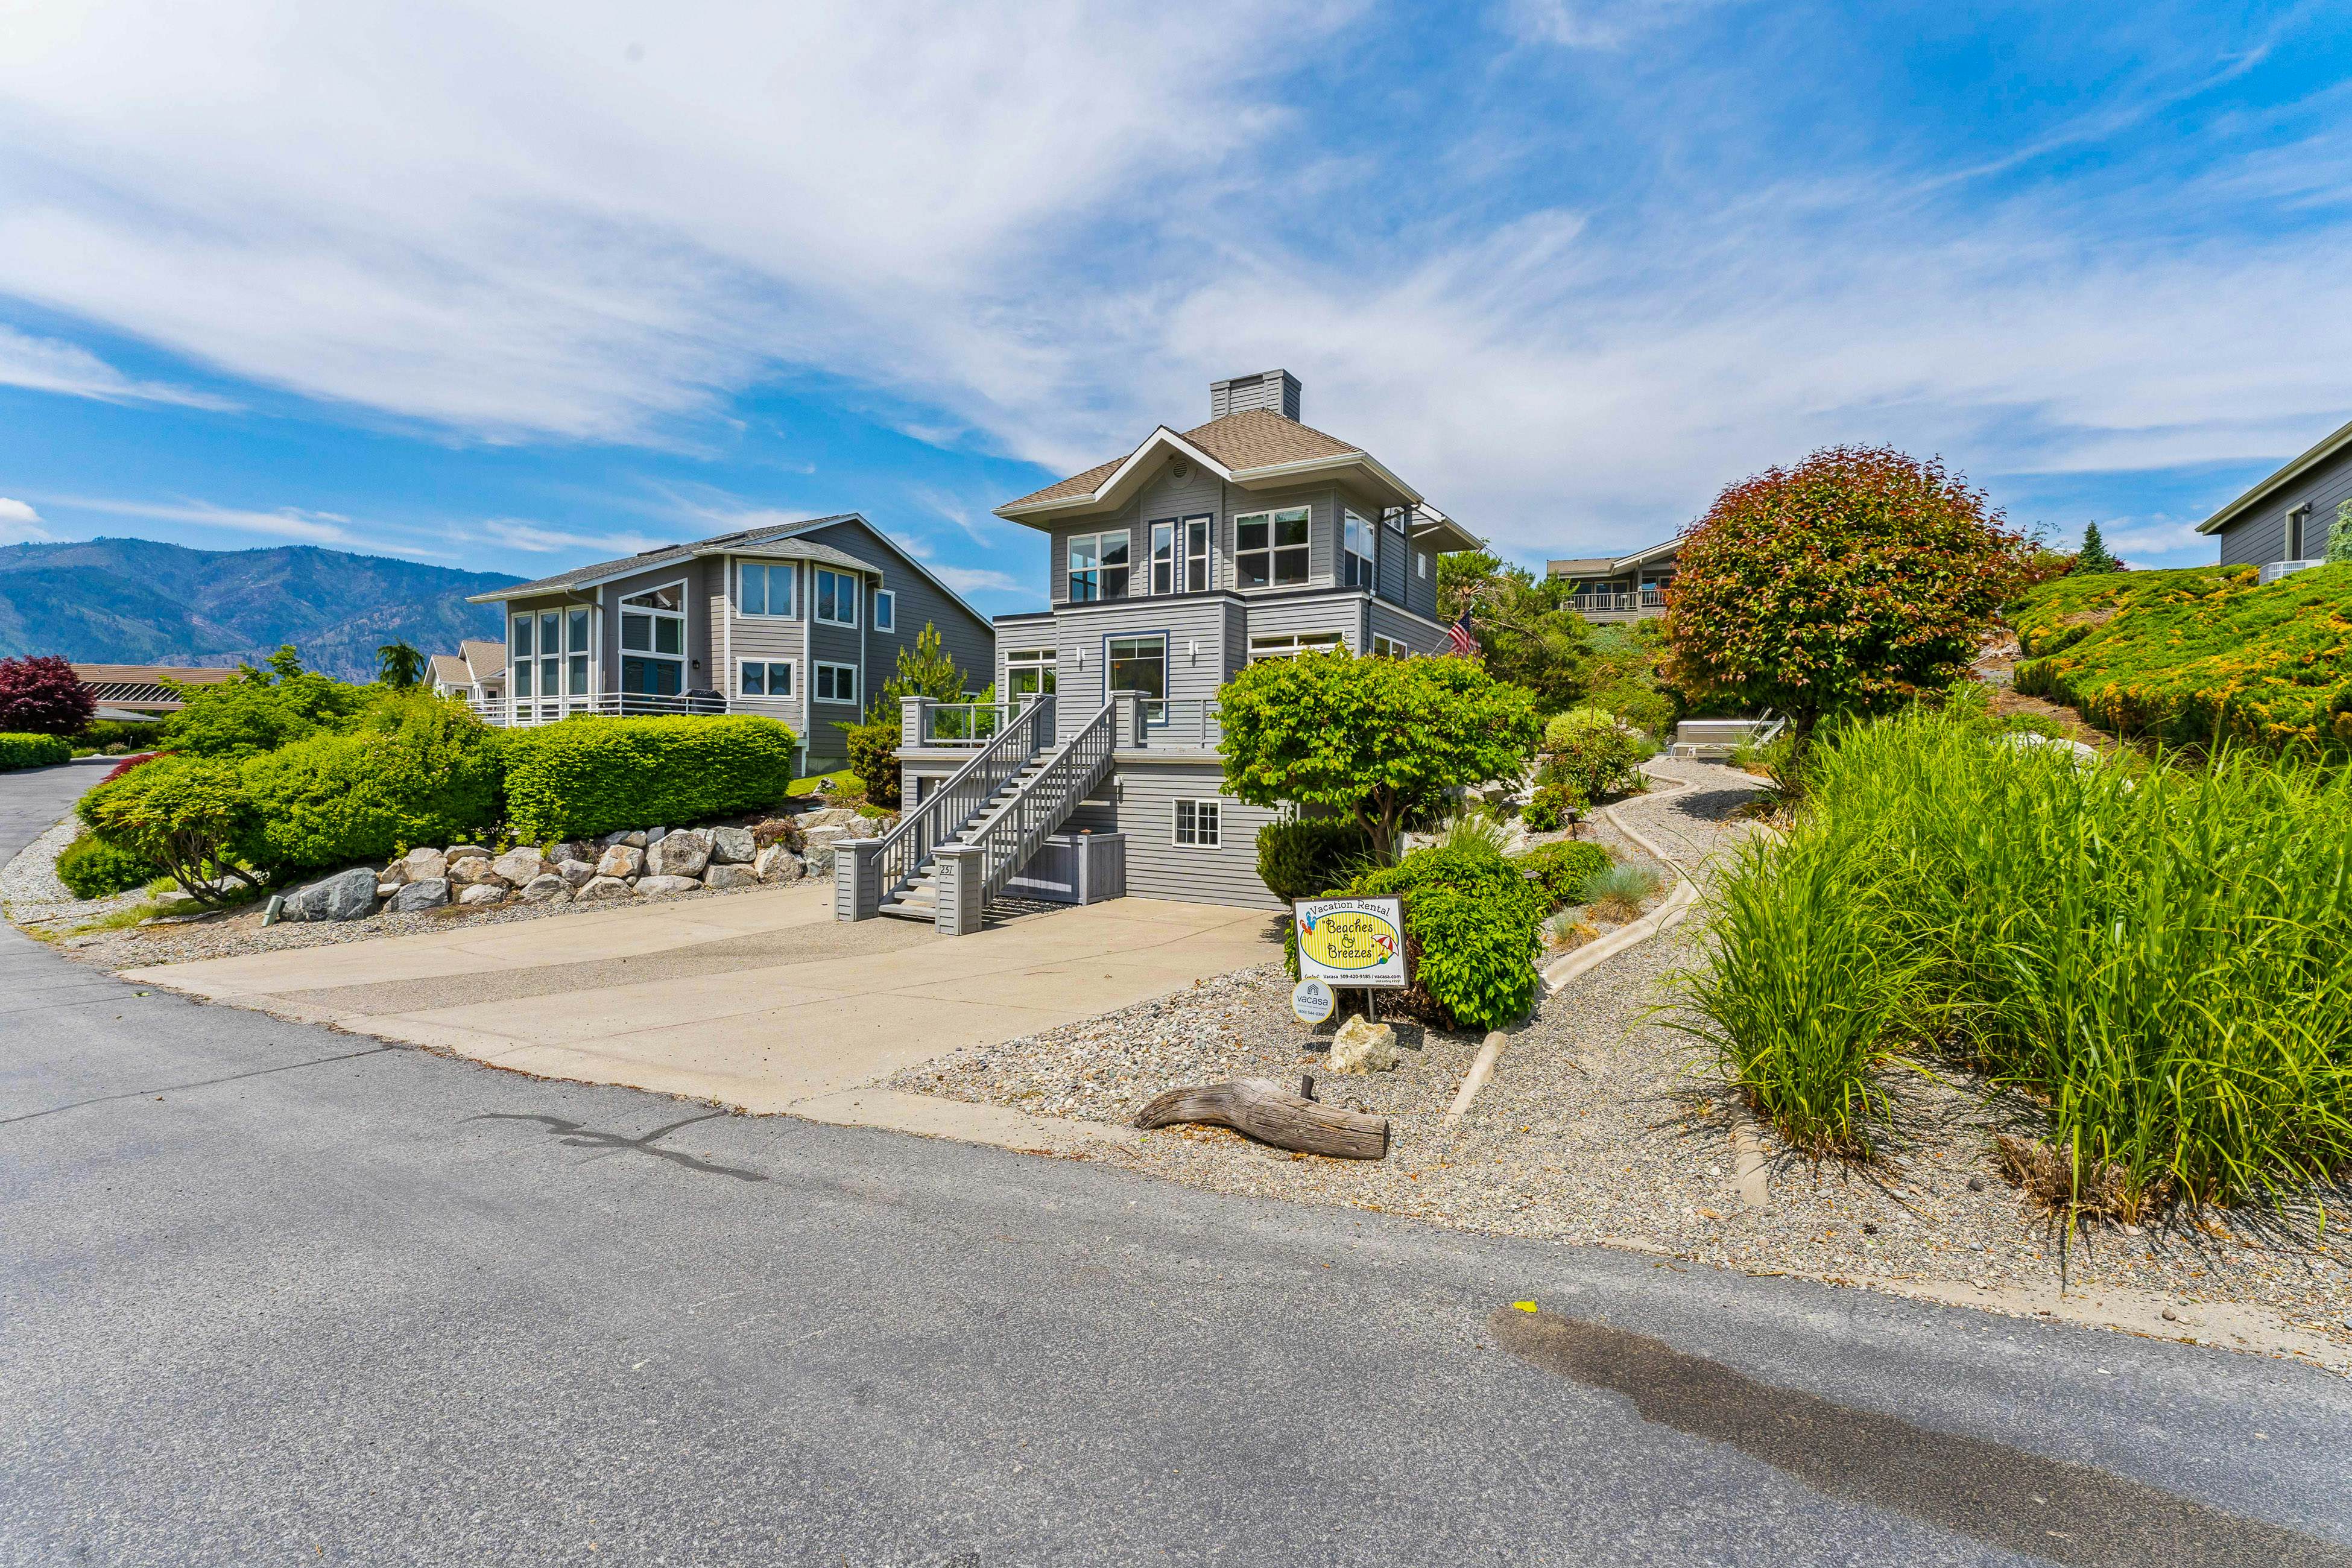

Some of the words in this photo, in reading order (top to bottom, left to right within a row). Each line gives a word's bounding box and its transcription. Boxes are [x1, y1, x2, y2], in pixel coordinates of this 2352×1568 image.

[1310, 900, 1353, 915] Vacation
[1358, 900, 1390, 917] Rental
[1322, 918, 1373, 934] "Beaches
[1342, 934, 1355, 948] &
[1327, 943, 1374, 959] Breezes"
[1297, 995, 1329, 1006] vacasa
